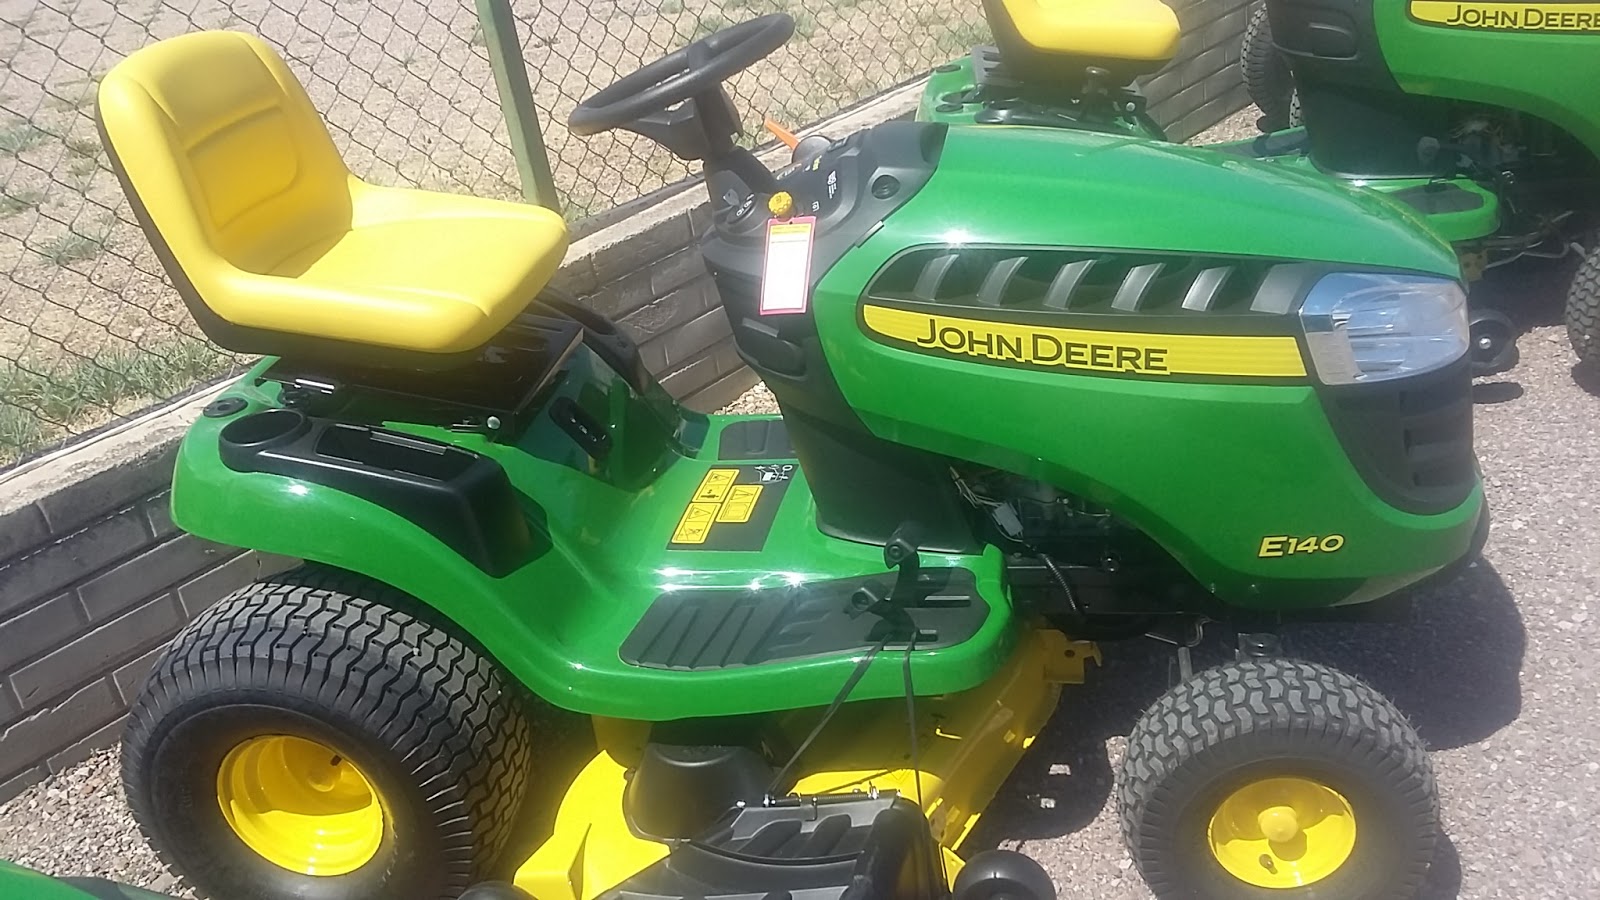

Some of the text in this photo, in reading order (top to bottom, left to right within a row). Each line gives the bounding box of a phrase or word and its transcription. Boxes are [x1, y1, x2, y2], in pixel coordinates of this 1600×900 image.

[1446, 5, 1518, 26] JOHN
[917, 318, 1168, 371] JOHN DEERE
[1258, 534, 1345, 558] E140
